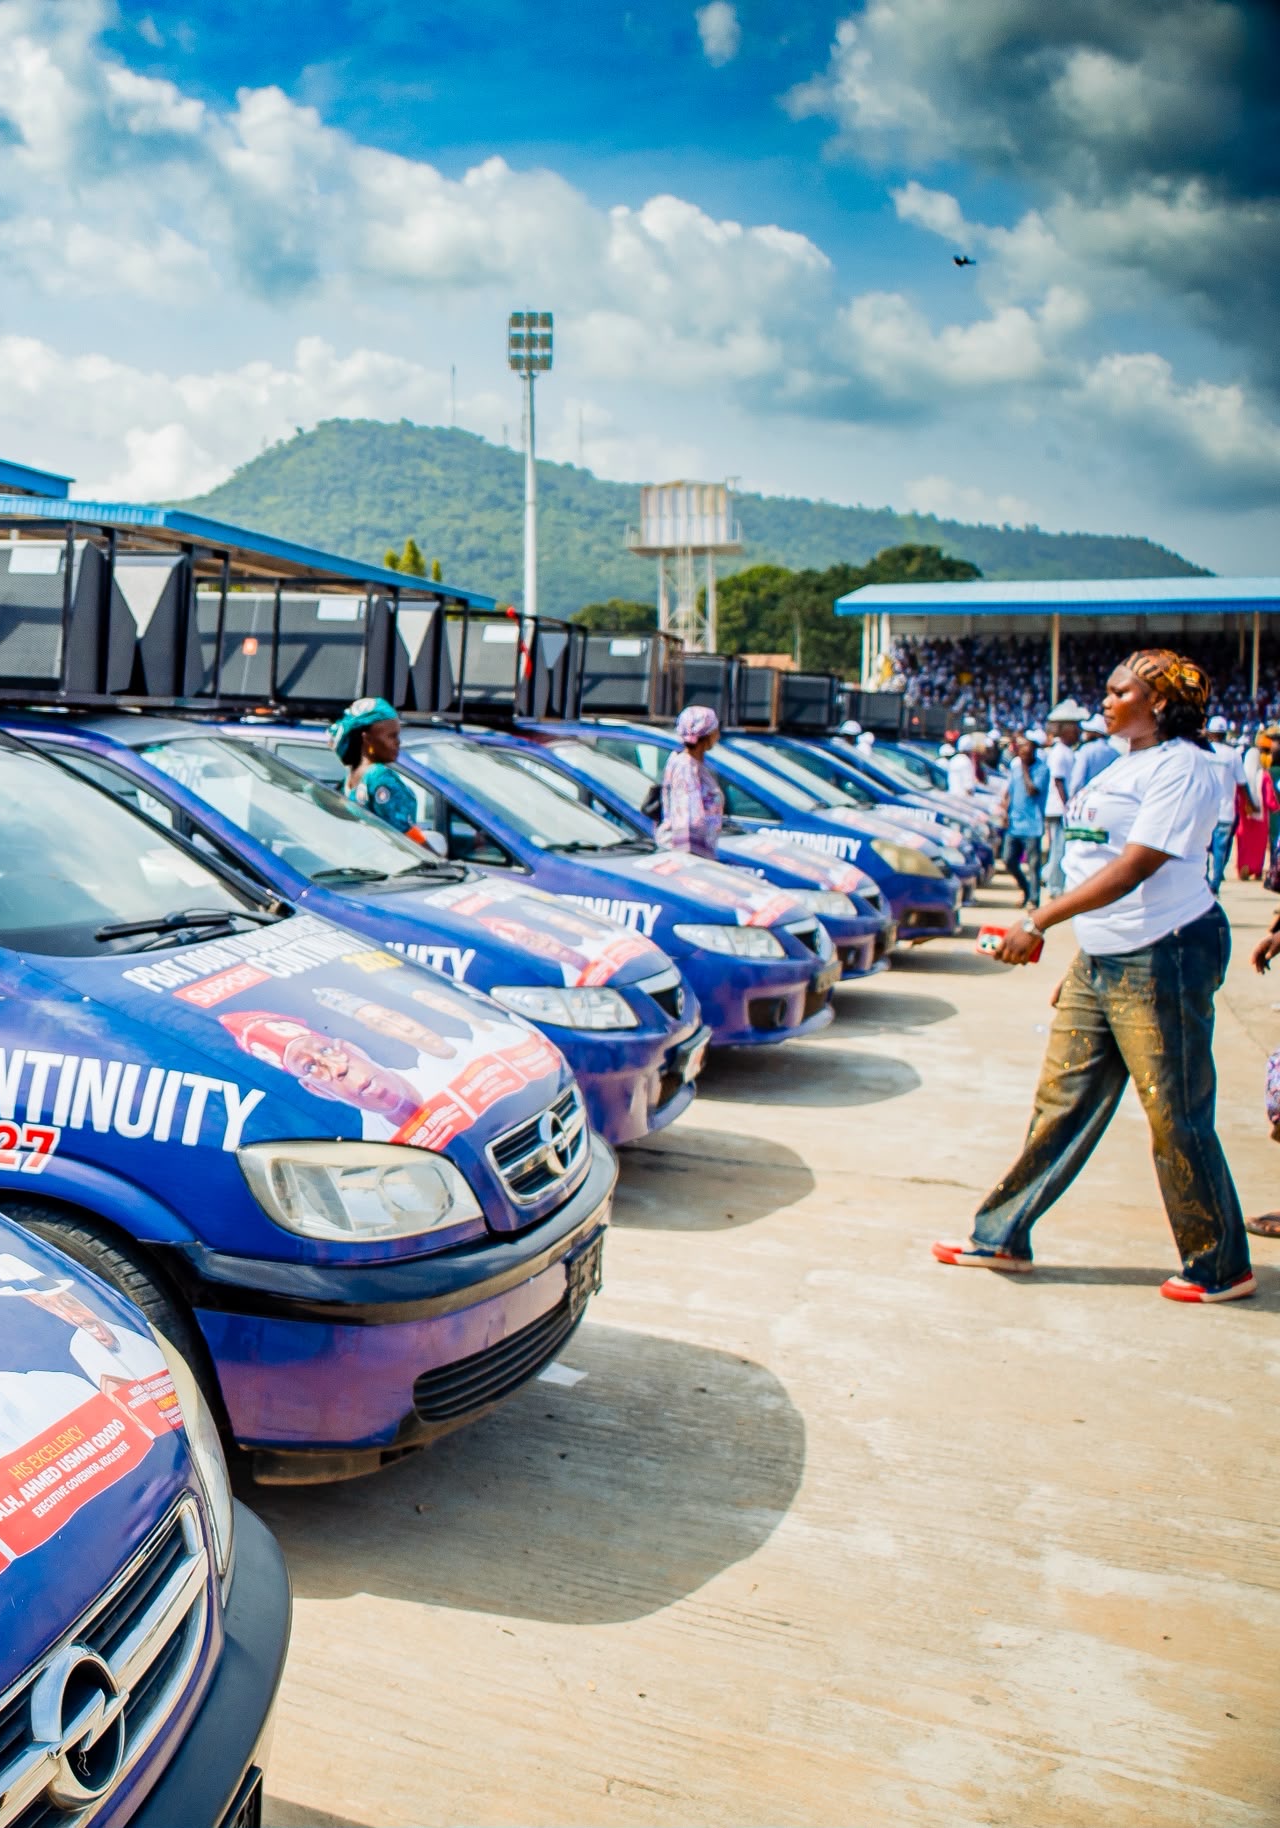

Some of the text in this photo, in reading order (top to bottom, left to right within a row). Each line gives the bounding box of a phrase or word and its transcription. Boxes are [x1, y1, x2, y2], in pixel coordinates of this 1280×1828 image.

[8, 1425, 86, 1481] HIS EXCELLENCY
[18, 1466, 62, 1502] AHMED
[56, 1440, 99, 1472] USMAN
[91, 1418, 126, 1449] ODODO
[31, 1485, 70, 1518] EXECUTIVE
[98, 1453, 116, 1468] KOGI
[113, 1440, 131, 1456] STATE
